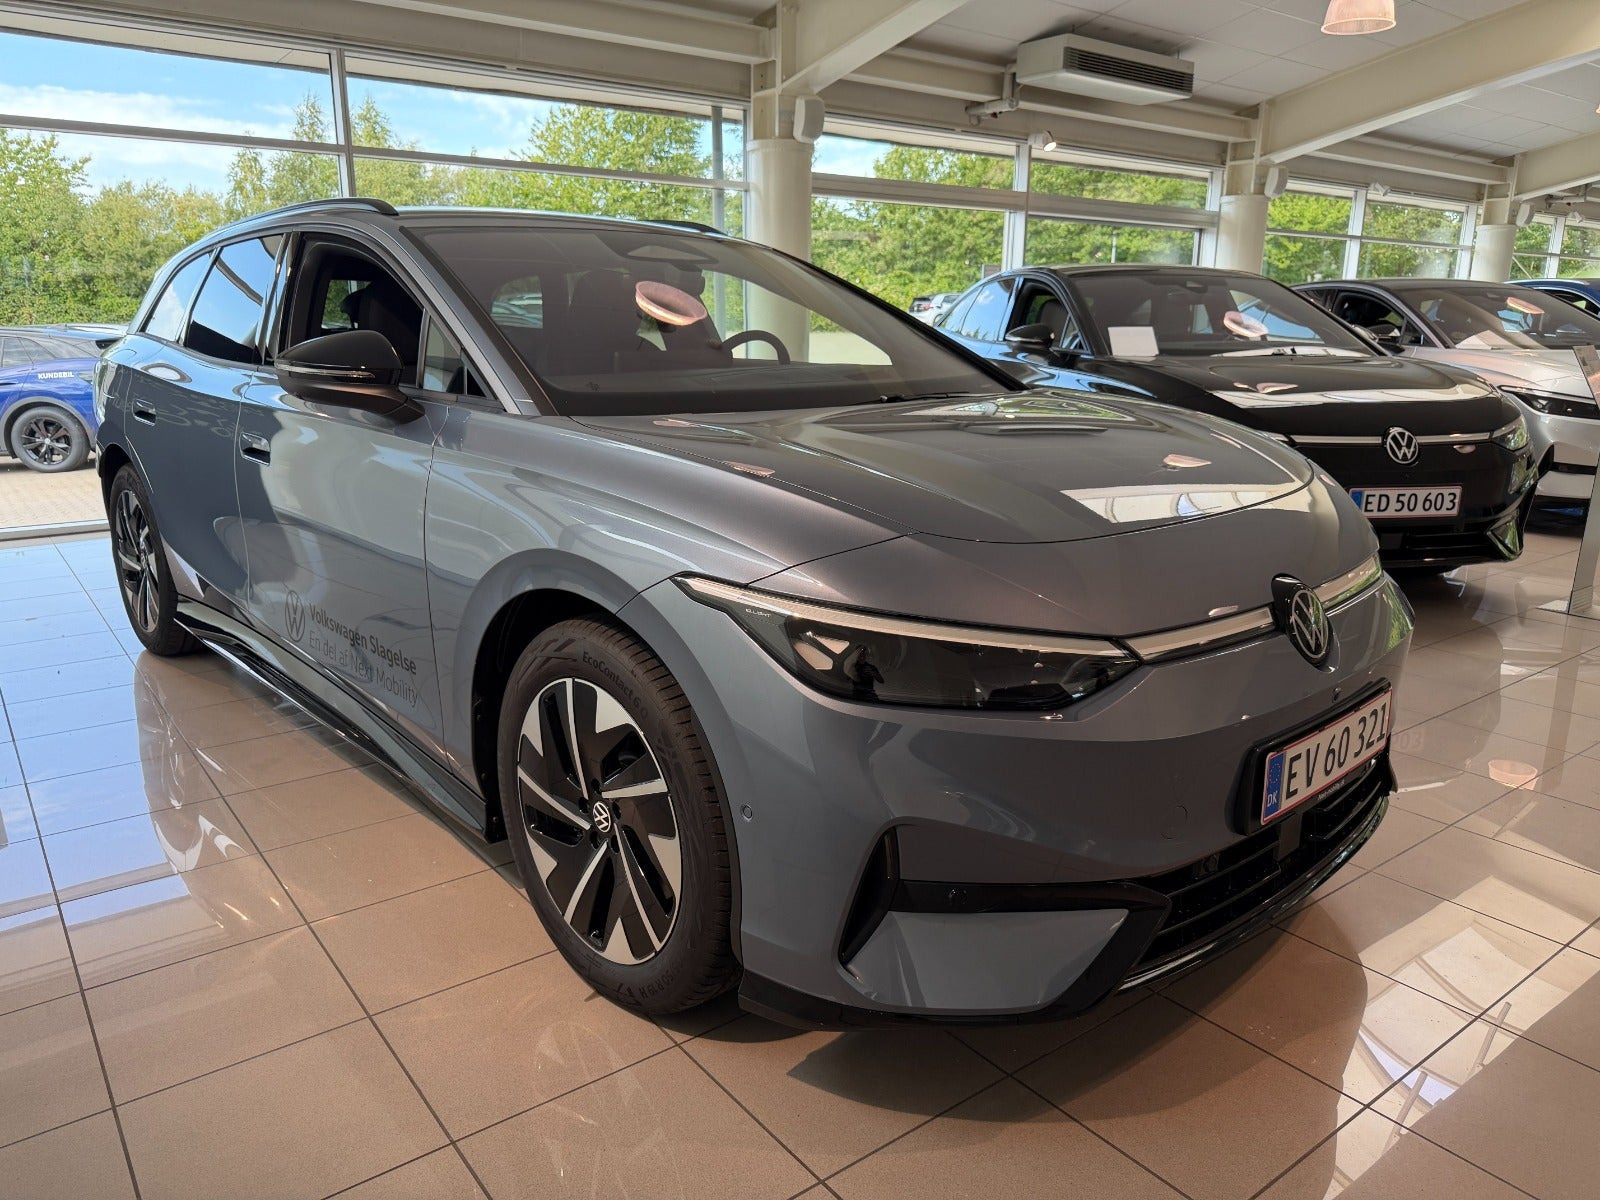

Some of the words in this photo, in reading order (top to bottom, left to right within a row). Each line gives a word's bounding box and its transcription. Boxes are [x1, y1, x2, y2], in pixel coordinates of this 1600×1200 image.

[37, 371, 75, 380] KUNDEBIL
[1364, 494, 1390, 513] ED
[1395, 493, 1418, 512] 50
[1422, 492, 1457, 511] 603
[309, 603, 367, 649] Volkswagen
[369, 634, 416, 675] Slagelse
[309, 630, 320, 653] En
[323, 639, 337, 660] del
[340, 649, 349, 667] af
[351, 653, 374, 680] Next
[376, 666, 418, 708] Mobility
[582, 650, 634, 700] EcoContact
[1286, 742, 1320, 800] EV
[1324, 726, 1350, 777] 60
[1354, 702, 1387, 759] 321
[1267, 790, 1279, 808] DK
